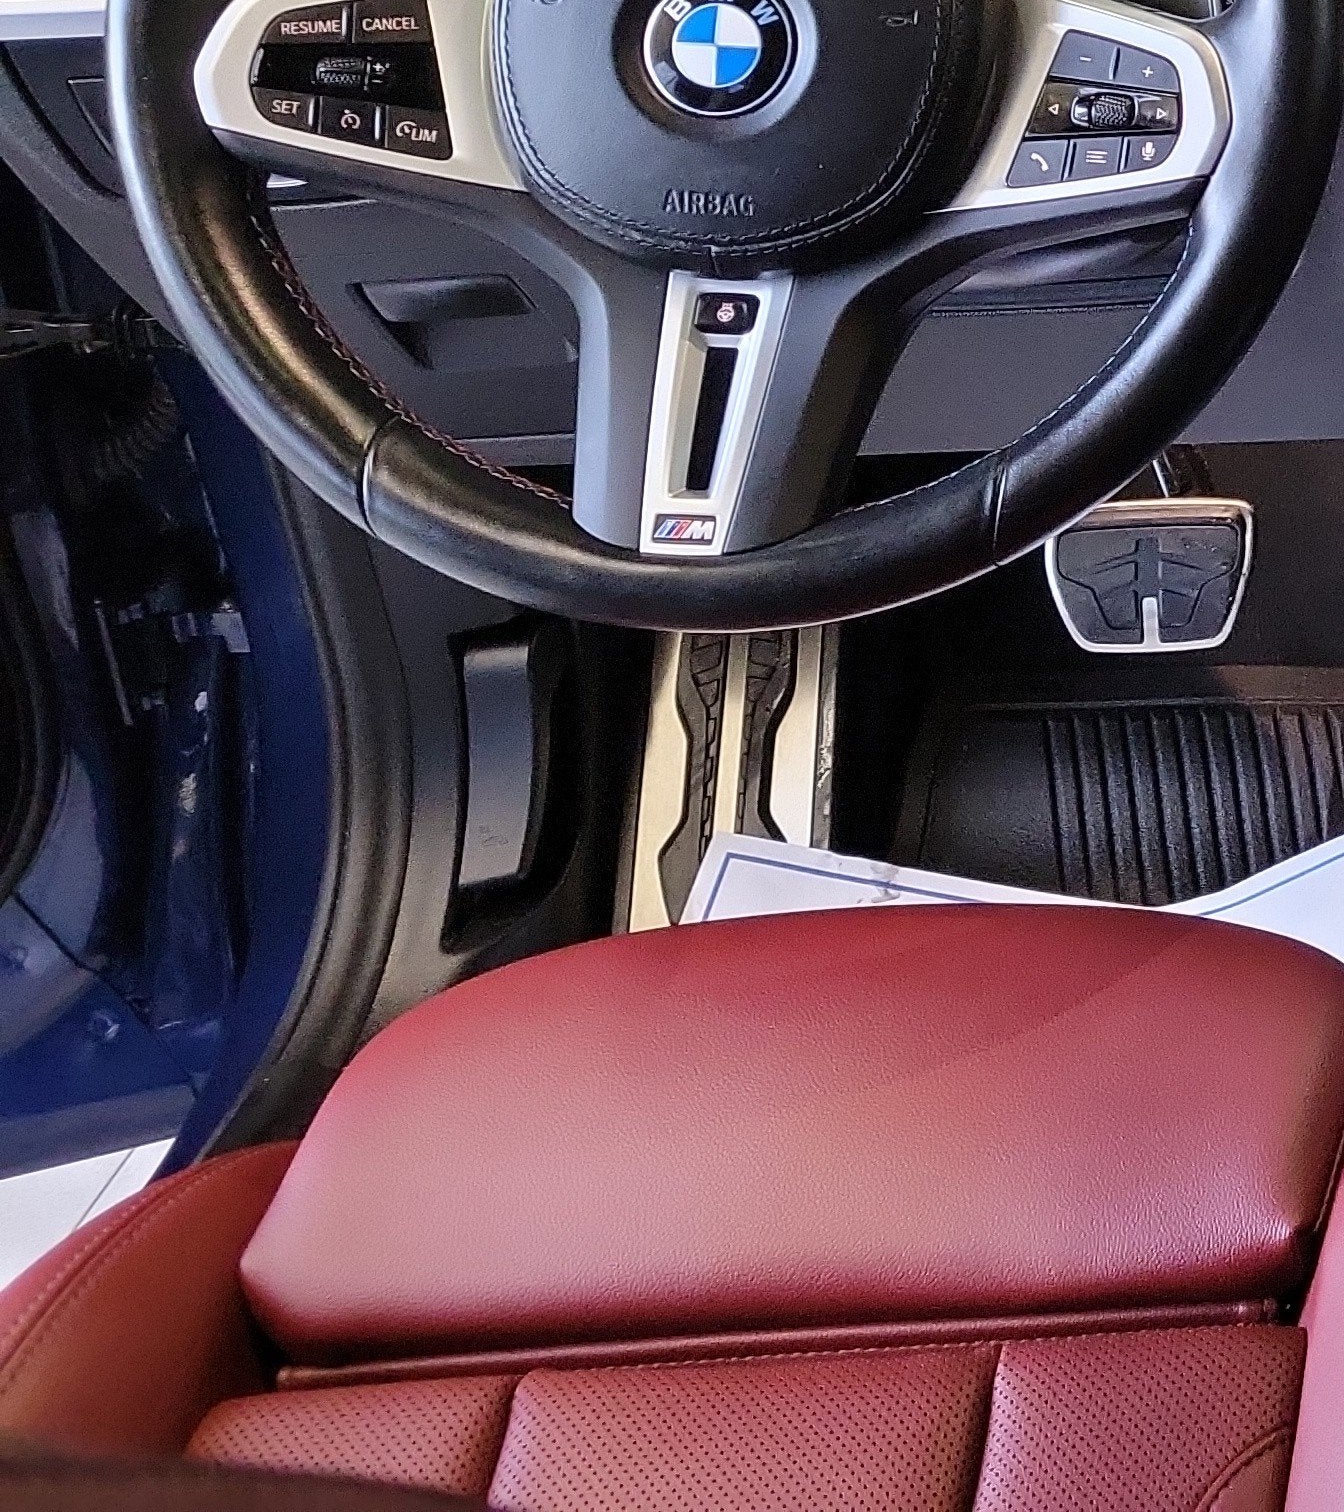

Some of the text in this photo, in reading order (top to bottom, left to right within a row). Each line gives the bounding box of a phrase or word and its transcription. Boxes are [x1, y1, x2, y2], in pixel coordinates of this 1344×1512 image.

[280, 18, 341, 36] RESUME
[362, 16, 420, 32] CANCEL
[271, 99, 301, 116] SET
[663, 188, 755, 217] AIRBAG
